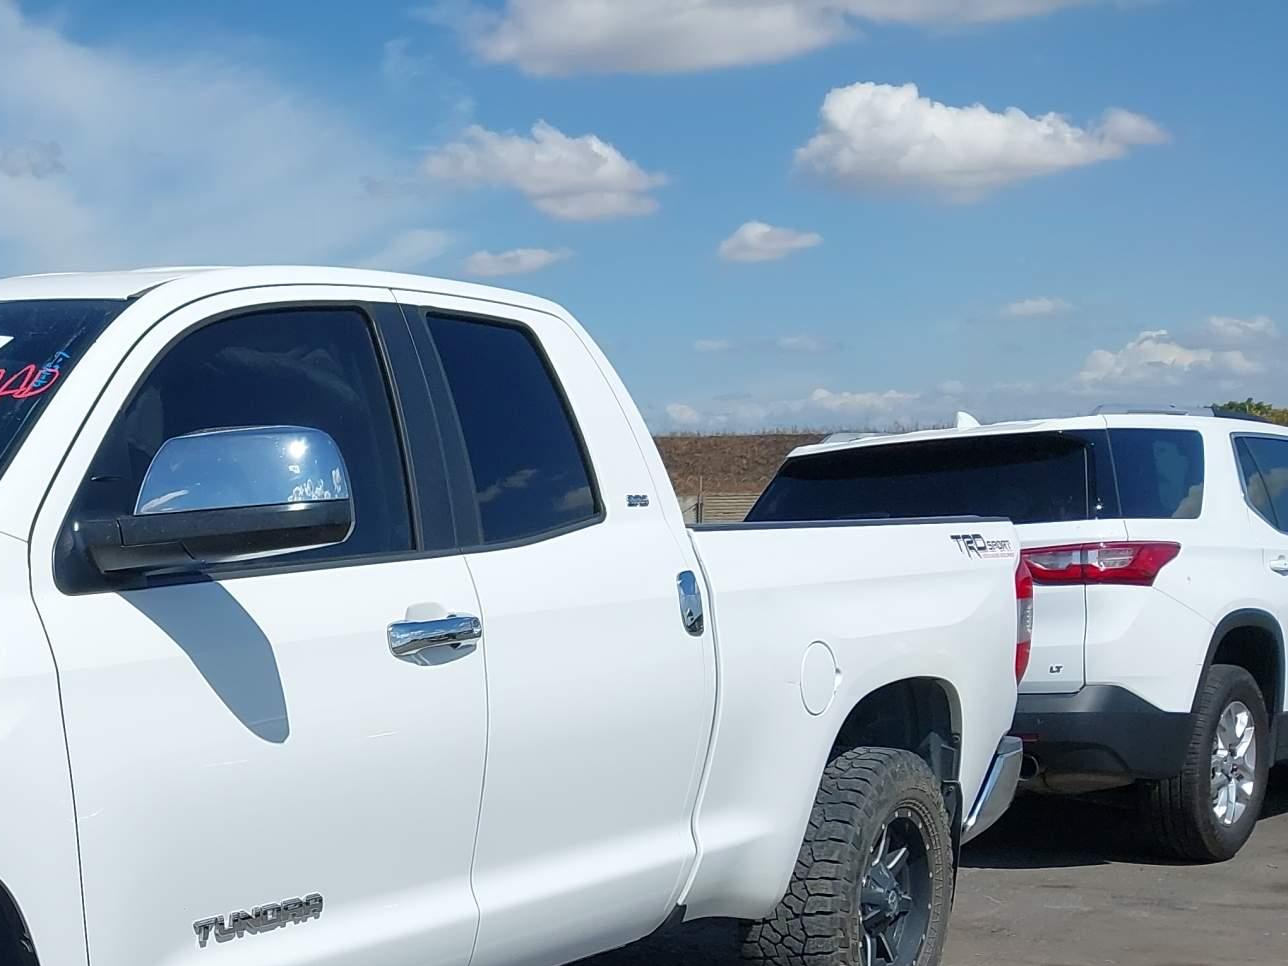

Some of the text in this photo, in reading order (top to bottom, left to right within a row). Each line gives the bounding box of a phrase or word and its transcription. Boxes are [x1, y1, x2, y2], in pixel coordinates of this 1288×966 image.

[950, 533, 987, 559] TRD
[1049, 665, 1063, 674] LT
[192, 892, 324, 949] TUNDRA
